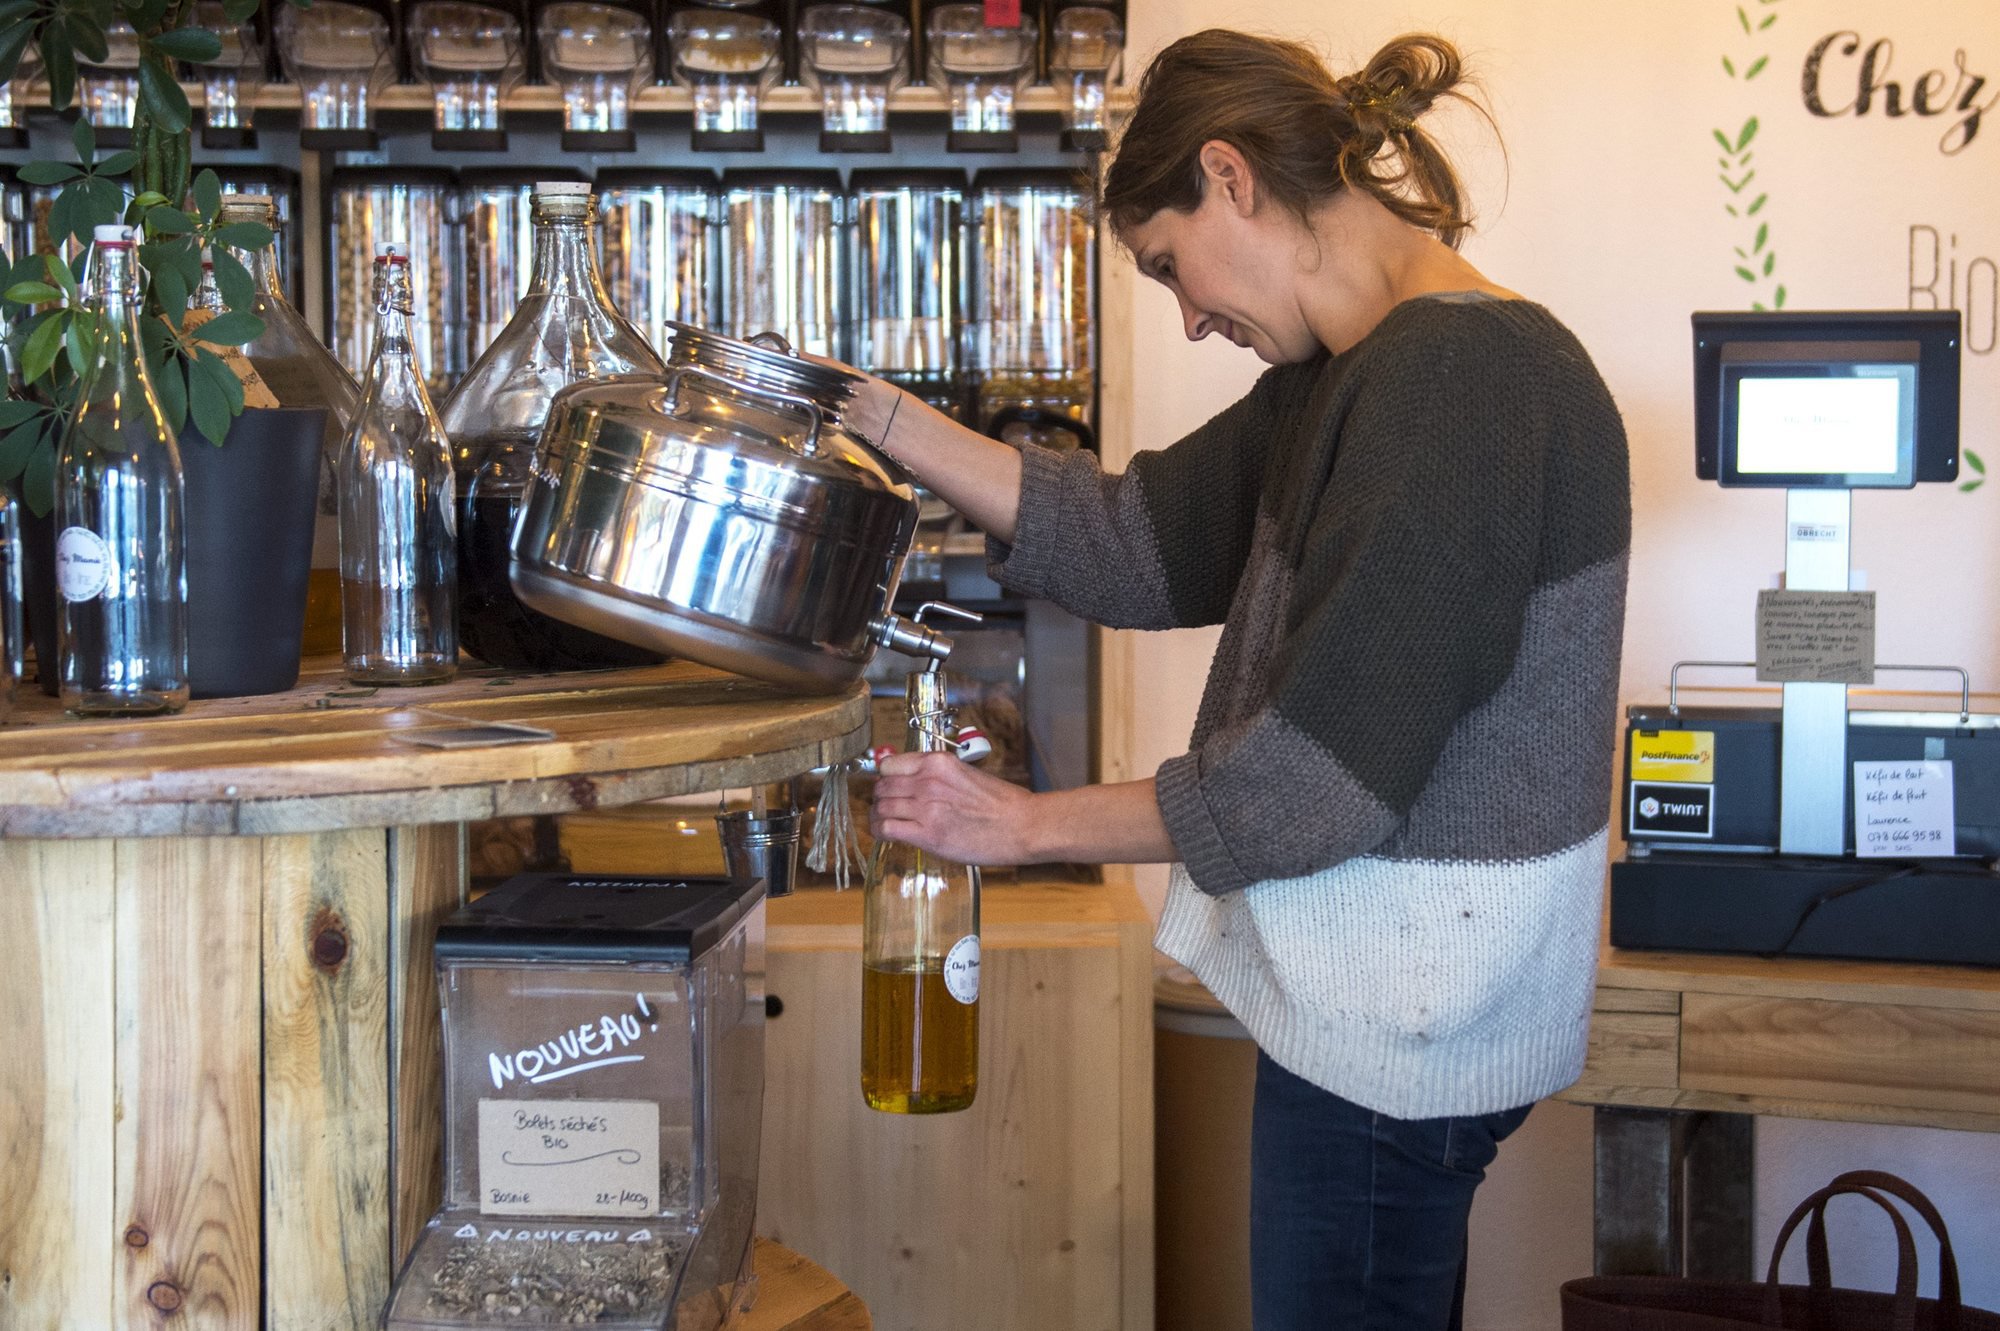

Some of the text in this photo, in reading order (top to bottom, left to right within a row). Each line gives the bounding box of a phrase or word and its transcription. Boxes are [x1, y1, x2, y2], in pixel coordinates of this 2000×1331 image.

[1801, 30, 2000, 156] Chez
[1909, 224, 1998, 355] Bio
[1797, 529, 1837, 538] OBRECHT
[1641, 750, 1700, 761] PostFinance
[1890, 768, 1901, 780] de
[1905, 767, 1925, 781] lait
[1892, 789, 1903, 801] de
[1662, 803, 1704, 817] TWINT
[1867, 814, 1912, 826] Laurence
[514, 1110, 608, 1132] Bolets séchés
[541, 1134, 569, 1150] BIO
[491, 1188, 531, 1204] Bosnie
[486, 1228, 620, 1243] NOUVEAU
